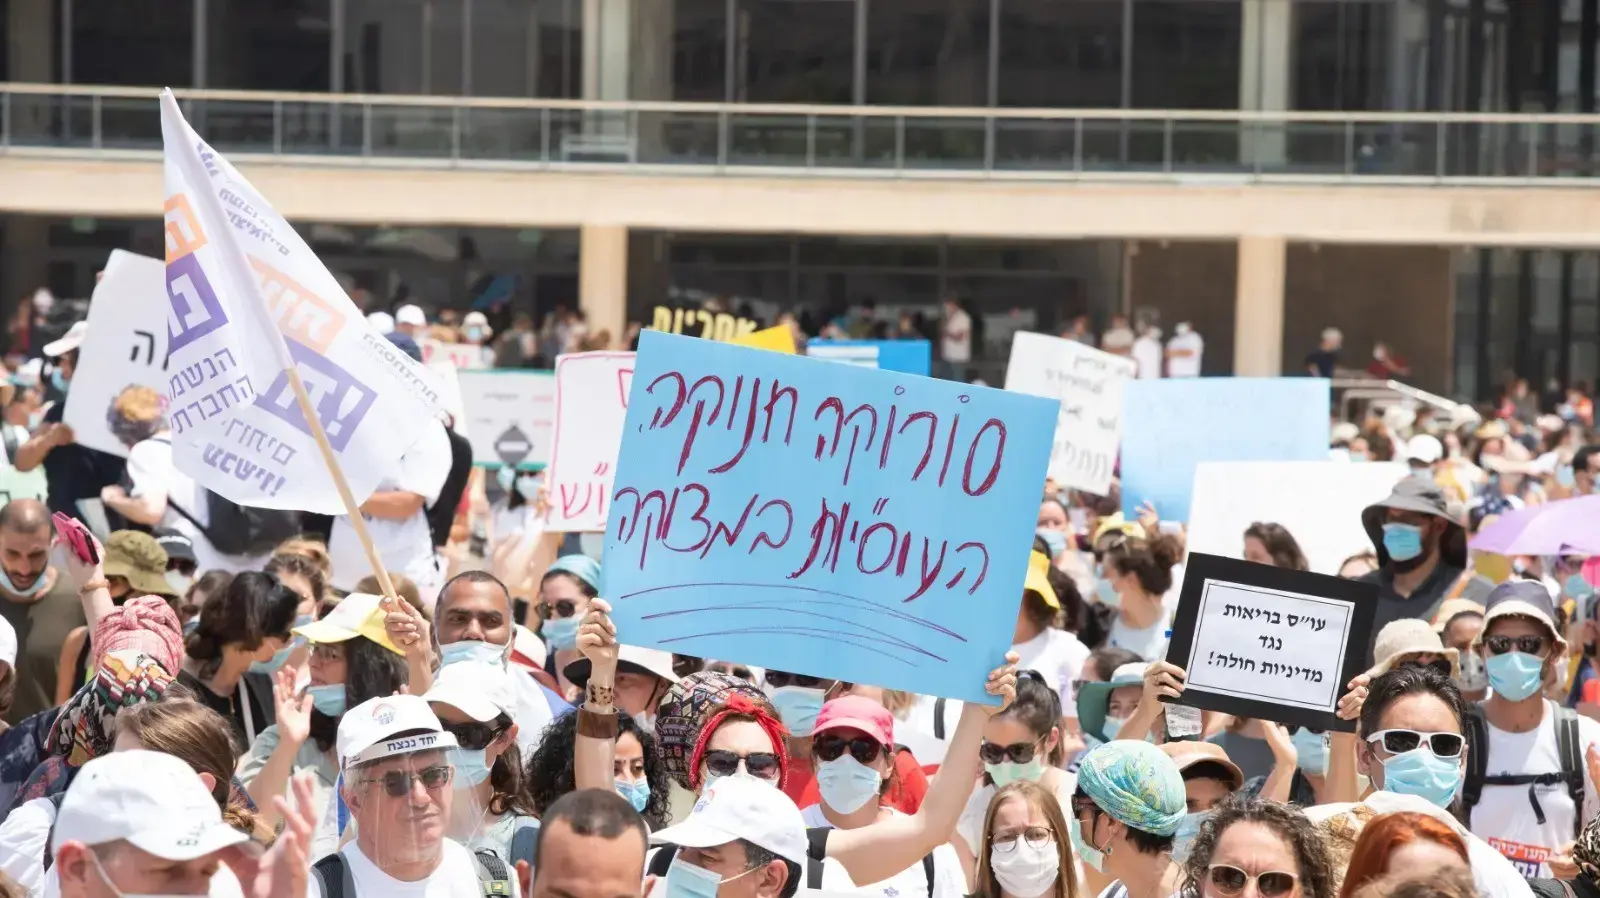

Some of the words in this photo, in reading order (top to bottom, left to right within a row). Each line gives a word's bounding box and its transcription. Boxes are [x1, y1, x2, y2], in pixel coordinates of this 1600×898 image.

[168, 346, 238, 402] הנשמ
[1222, 602, 1282, 625] בריאות
[1258, 634, 1283, 651] נגד
[1207, 650, 1256, 672] חולה!
[1259, 659, 1323, 683] מדיניות
